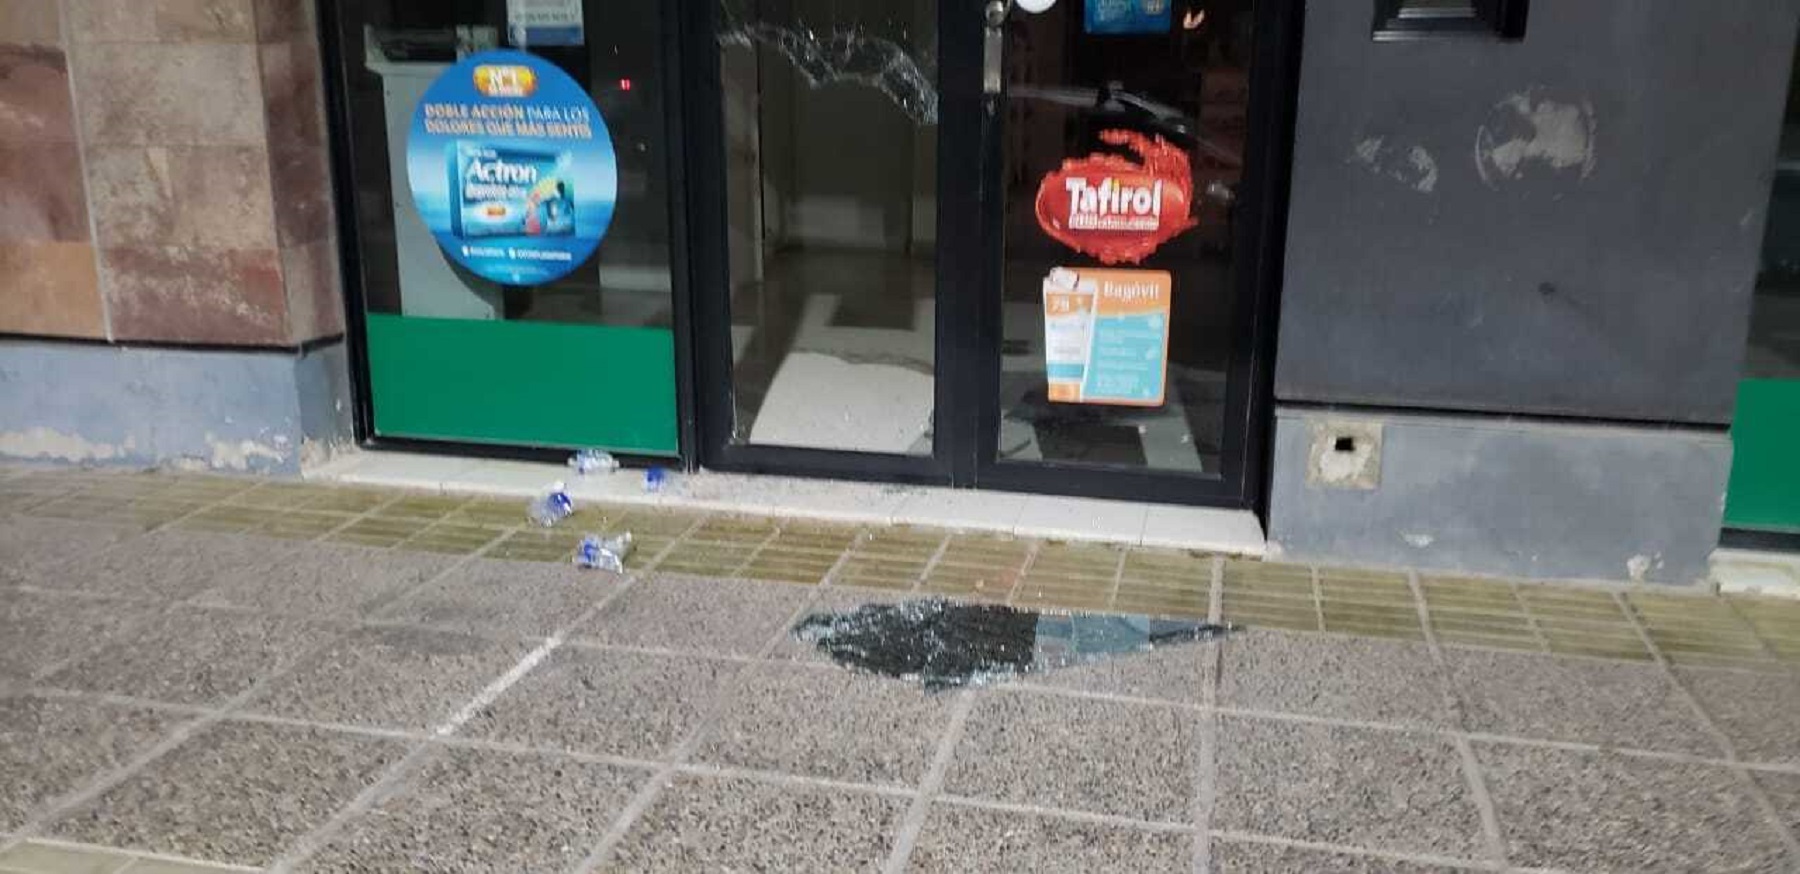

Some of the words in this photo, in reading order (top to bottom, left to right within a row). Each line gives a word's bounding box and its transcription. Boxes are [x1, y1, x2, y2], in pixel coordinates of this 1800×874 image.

[425, 103, 468, 118] DOBLE
[527, 106, 561, 121] PARA
[564, 107, 590, 122] LOS
[425, 119, 484, 135] DOLORES
[486, 121, 514, 136] QUE
[467, 158, 537, 183] Actron
[1066, 177, 1163, 217] Tafirol
